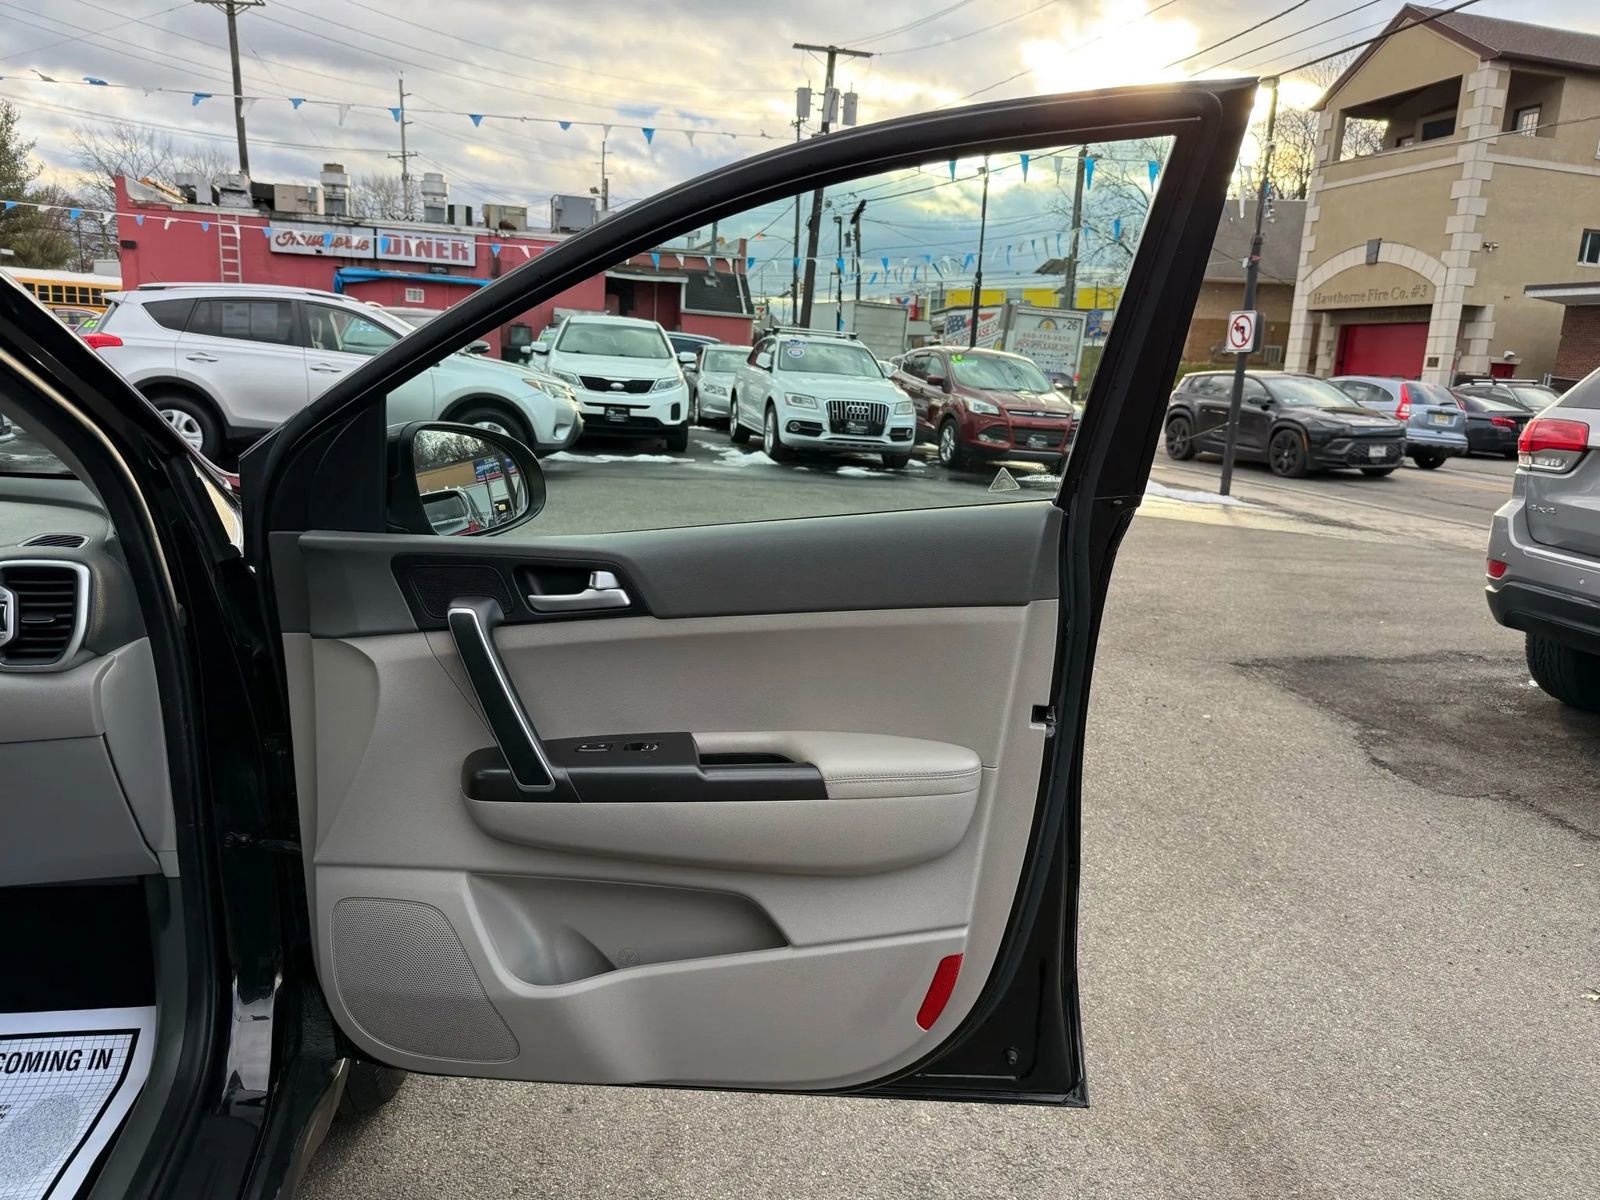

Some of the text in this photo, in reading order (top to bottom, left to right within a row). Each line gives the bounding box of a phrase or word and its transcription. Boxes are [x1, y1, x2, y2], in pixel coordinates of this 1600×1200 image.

[383, 233, 469, 261] DINER
[1313, 284, 1428, 305] Hawthorne Fire Co. #3
[88, 1049, 114, 1071] IN
